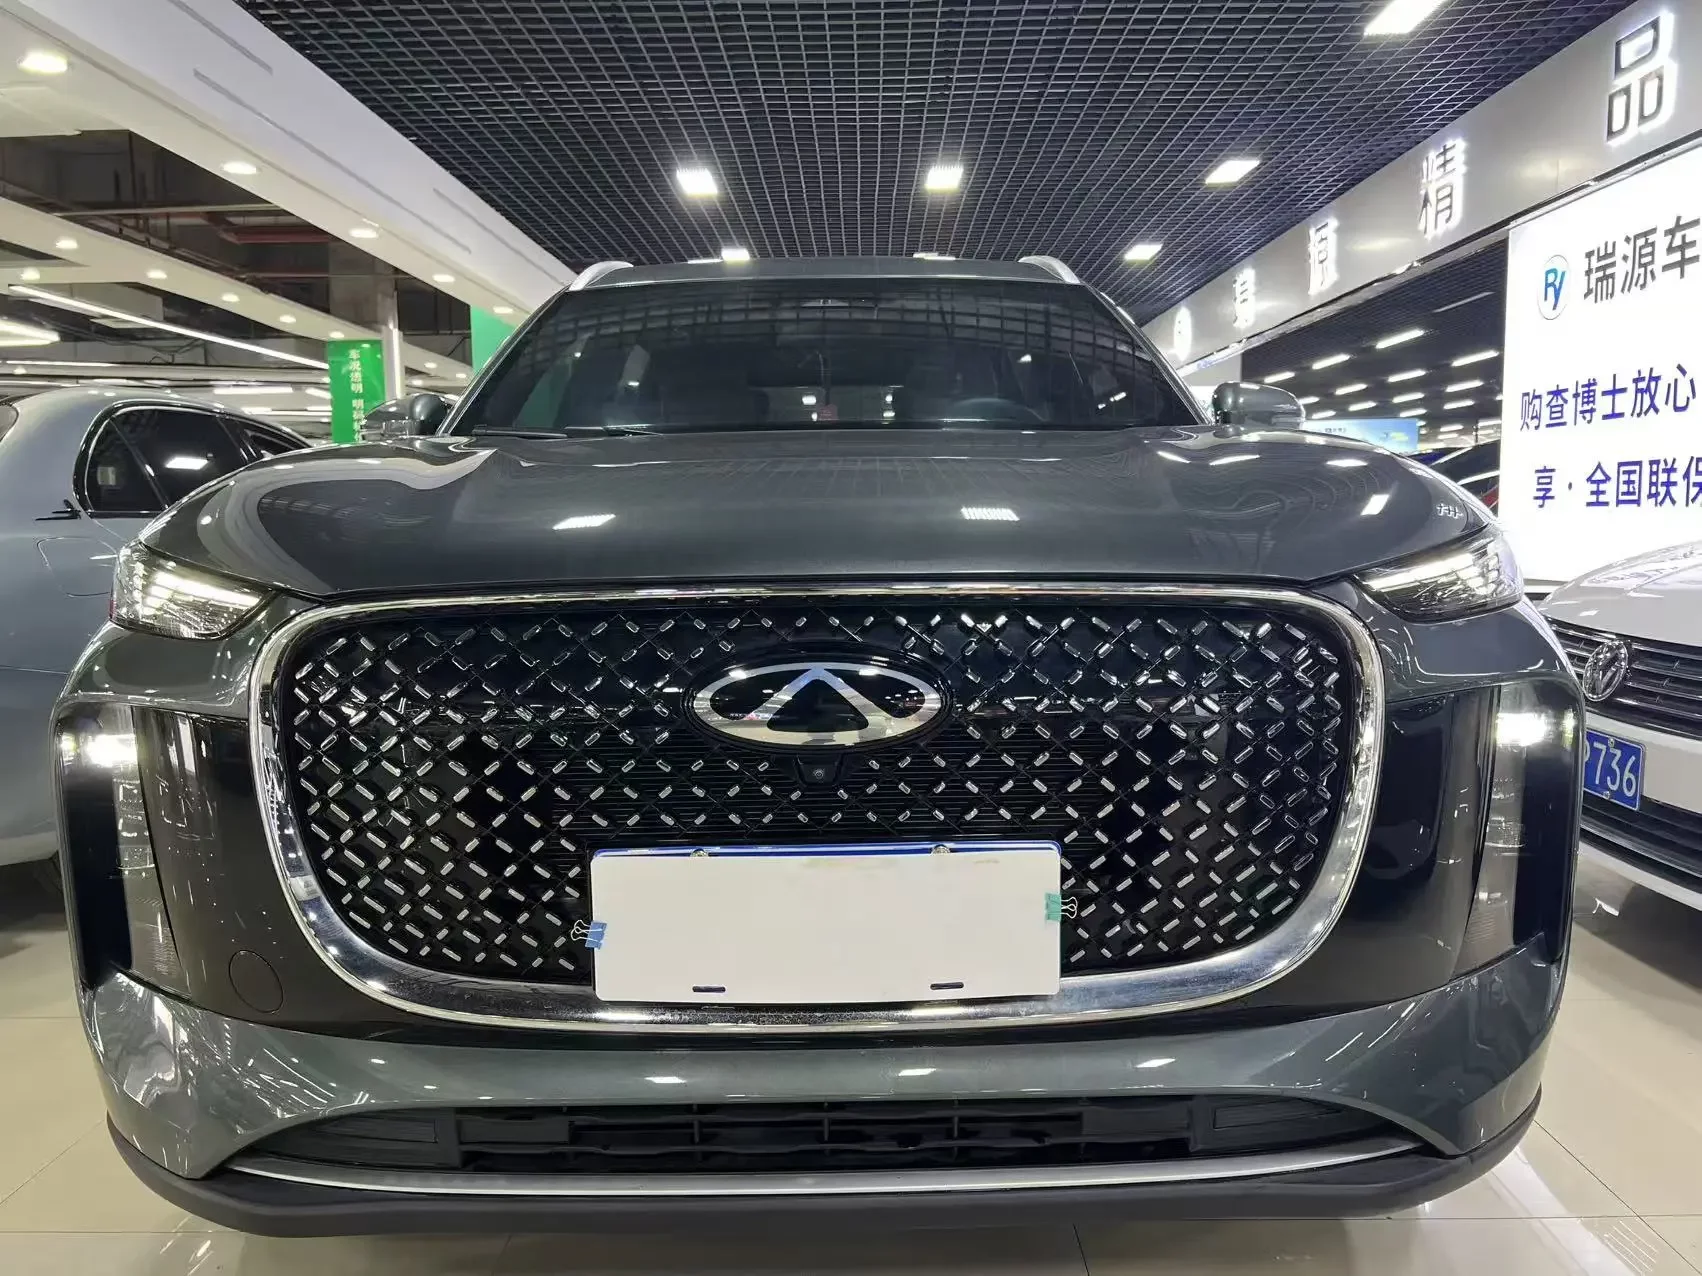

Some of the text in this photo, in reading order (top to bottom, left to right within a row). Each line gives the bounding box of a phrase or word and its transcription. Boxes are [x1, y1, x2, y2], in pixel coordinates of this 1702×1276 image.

[1583, 215, 1701, 304] 瑞源车
[1520, 363, 1697, 431] 购查博士放心
[1585, 740, 1637, 797] 736
